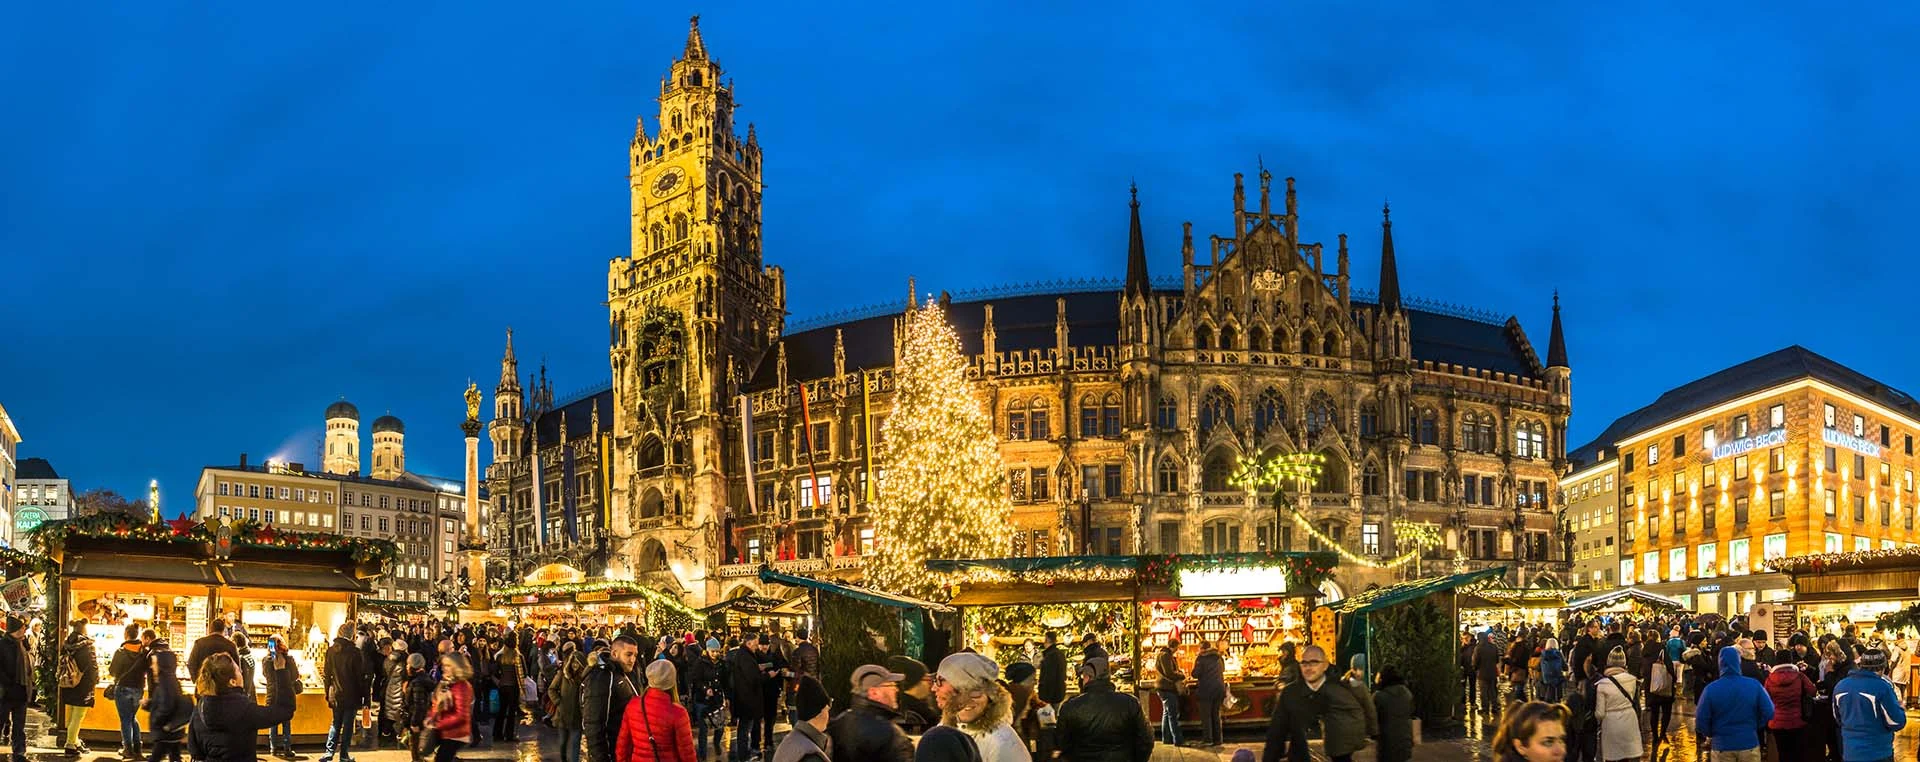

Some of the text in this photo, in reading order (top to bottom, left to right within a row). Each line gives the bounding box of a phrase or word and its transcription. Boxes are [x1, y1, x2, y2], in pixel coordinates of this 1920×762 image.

[1712, 430, 1786, 459] LUDWIG BECK
[1823, 428, 1880, 457] LUDWIG BECK
[537, 569, 573, 580] Glühwein
[576, 590, 609, 600] Glühwein
